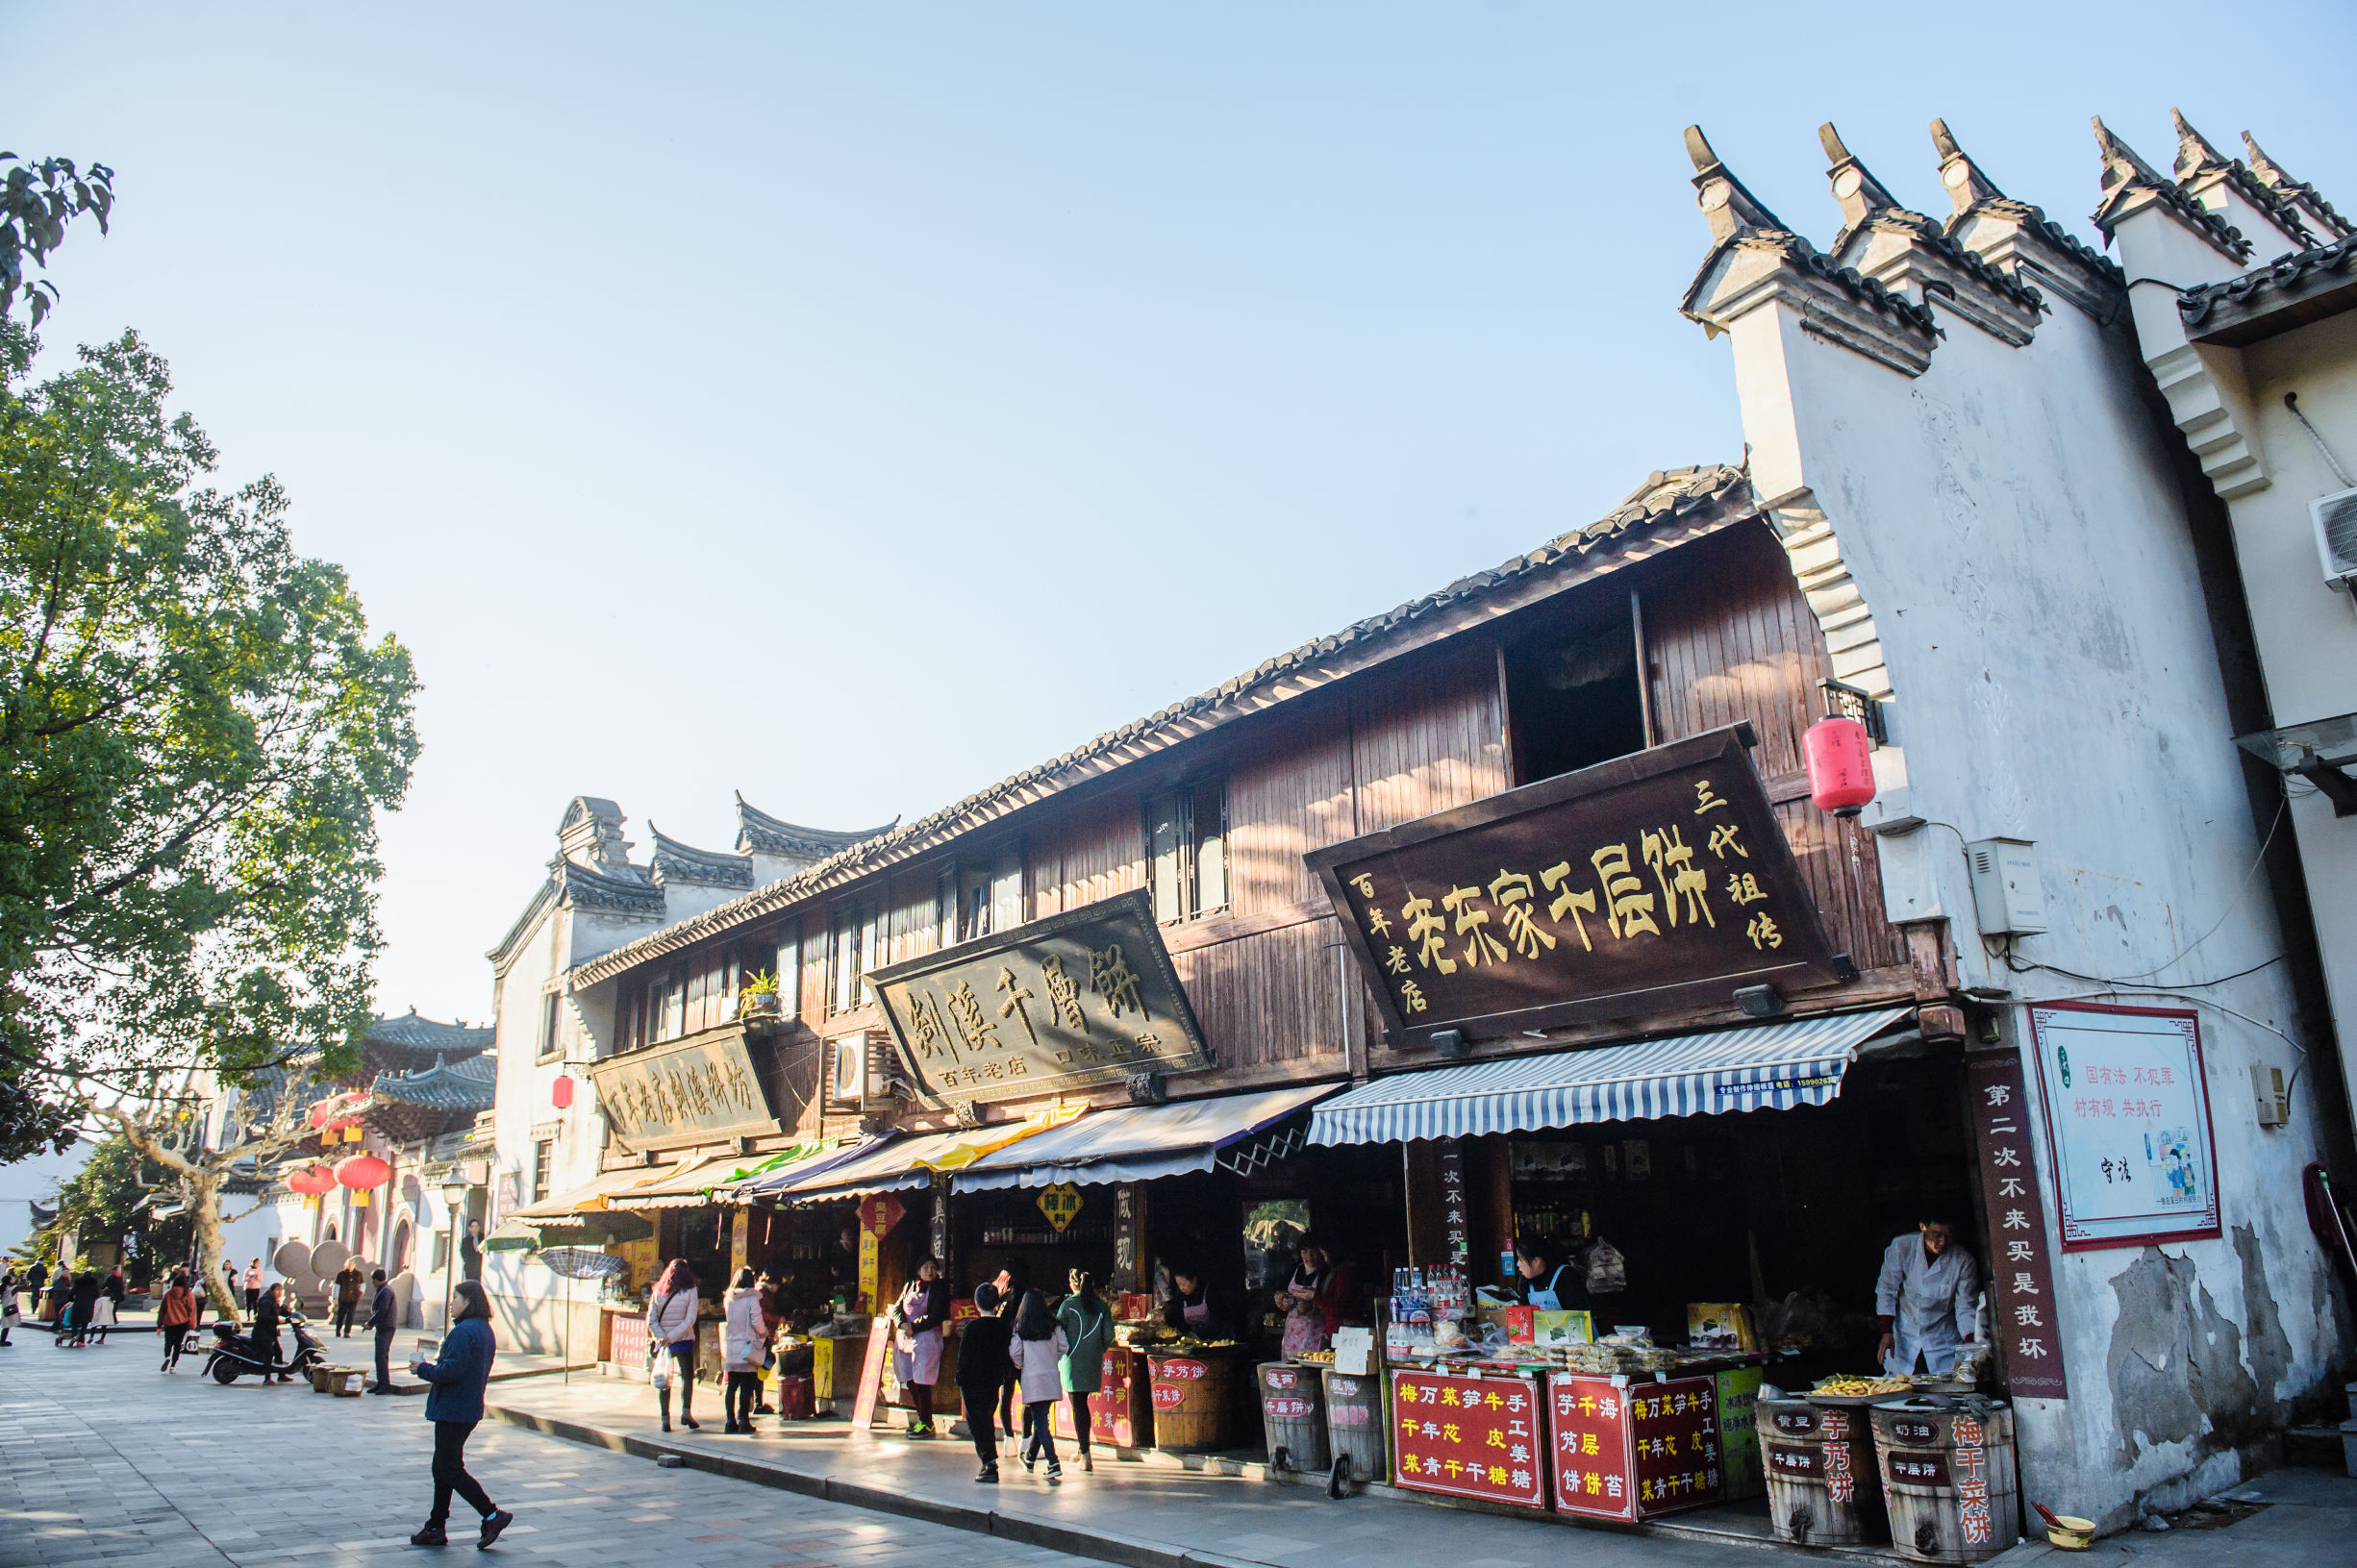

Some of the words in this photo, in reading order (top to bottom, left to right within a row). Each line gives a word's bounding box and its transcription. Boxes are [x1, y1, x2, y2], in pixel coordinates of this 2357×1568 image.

[1401, 824, 1716, 976] 老东家千层饼
[1693, 780, 1783, 951] 三代祖传
[1349, 872, 1428, 1015] 百年老店
[938, 1056, 1027, 1087] 百年老店
[1054, 1032, 1162, 1064] 口味正宗
[2086, 1065, 2127, 1085] 国有法
[2133, 1067, 2175, 1085] 不犯罪
[2074, 1098, 2116, 1118] 村有规
[2122, 1099, 2163, 1118] 共执行
[1984, 1084, 2047, 1360] 第二次不来买是我坏
[1399, 1383, 1422, 1473] 梅干菜
[1420, 1386, 1442, 1477] 万年青
[1441, 1386, 1465, 1480] 菜芯干
[1484, 1391, 1508, 1485] 牛皮糖
[1506, 1393, 1532, 1489] 手工姜糖
[1556, 1393, 1582, 1493] 芋艿饼
[1578, 1396, 1602, 1496] 千层饼
[1634, 1398, 1655, 1503] 梅干菜
[1647, 1397, 1667, 1499] 万年青
[1661, 1394, 1681, 1496] 菜芯干
[1687, 1392, 1707, 1491] 牛皮糖
[1699, 1390, 1719, 1488] 手工姜糖
[1774, 1453, 1811, 1469] 千层饼
[1777, 1415, 1811, 1429] 黄豆
[1820, 1410, 1855, 1503] 芋艿饼
[1894, 1424, 1930, 1437] 奶油
[1895, 1462, 1937, 1477] 千层饼
[1952, 1416, 1992, 1544] 梅干菜饼
